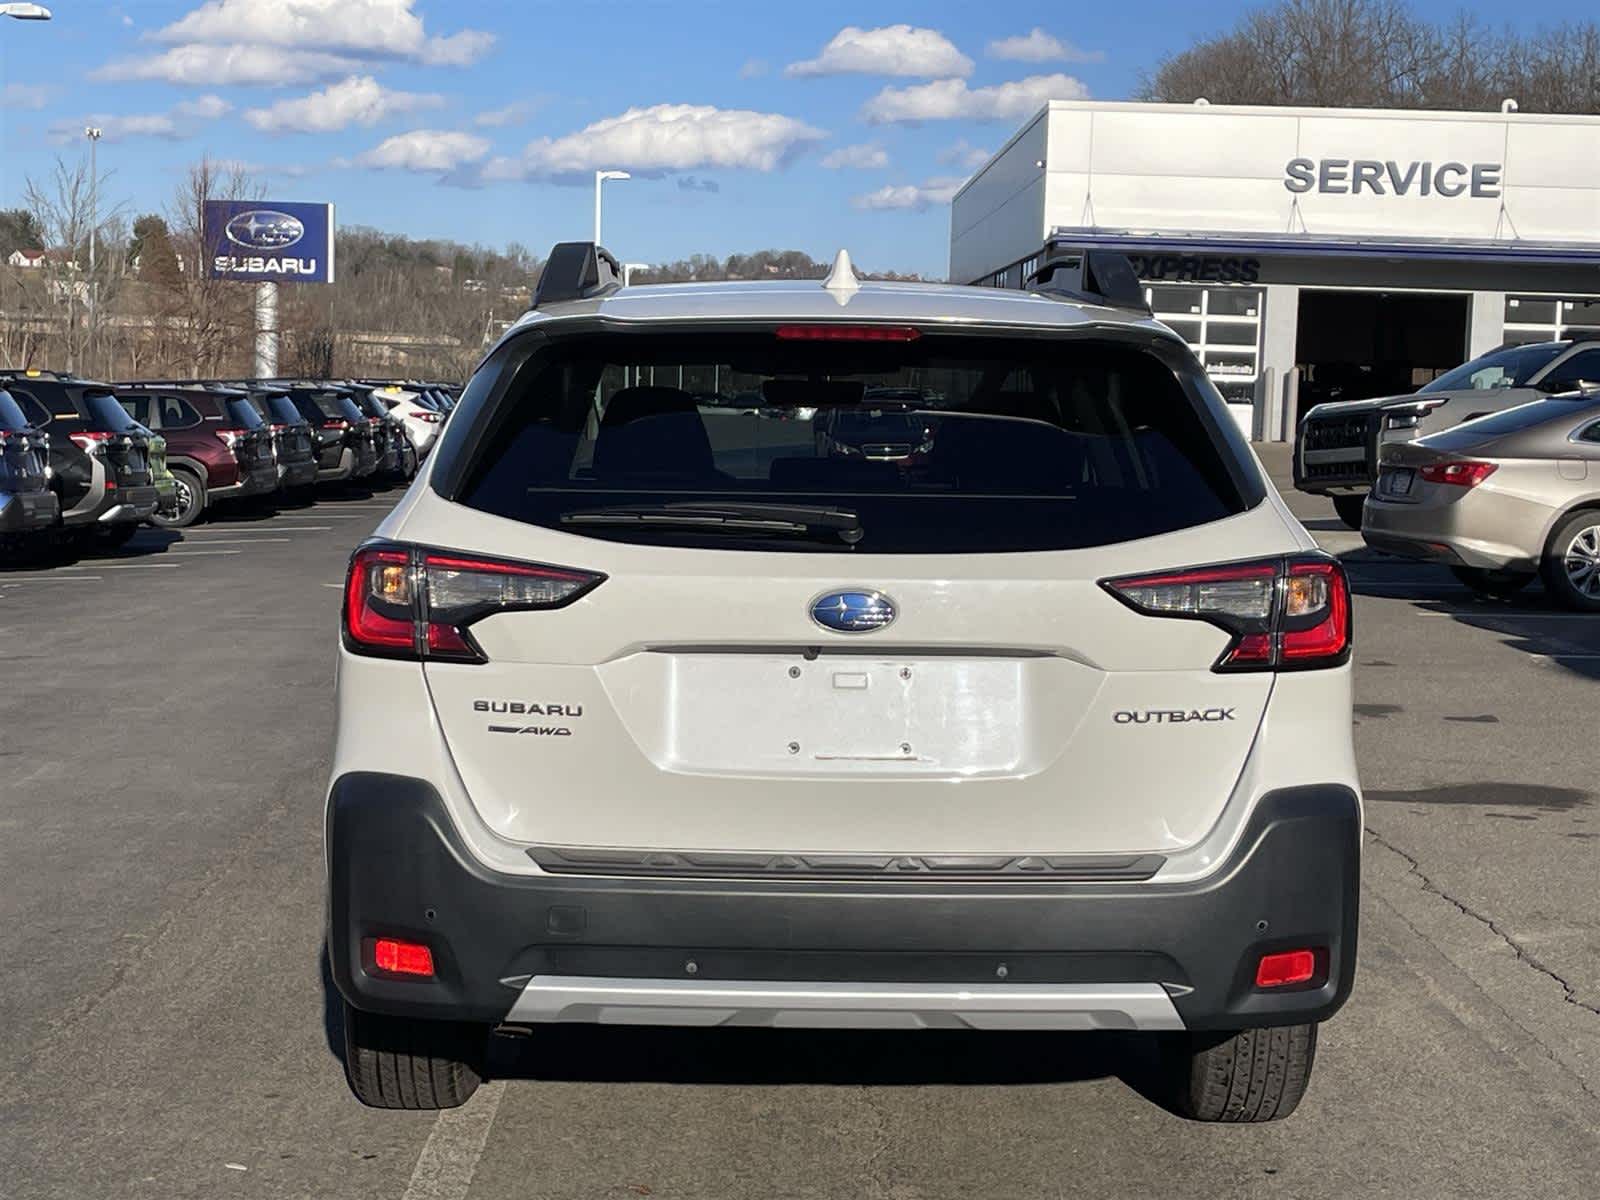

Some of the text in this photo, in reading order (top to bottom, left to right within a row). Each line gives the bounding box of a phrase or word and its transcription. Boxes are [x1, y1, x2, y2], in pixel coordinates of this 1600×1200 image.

[1284, 157, 1502, 198] SERVICE
[214, 256, 316, 275] SUBARU
[473, 700, 583, 717] SUBARU
[1114, 707, 1236, 724] OUTBACK
[519, 726, 573, 737] AWD
